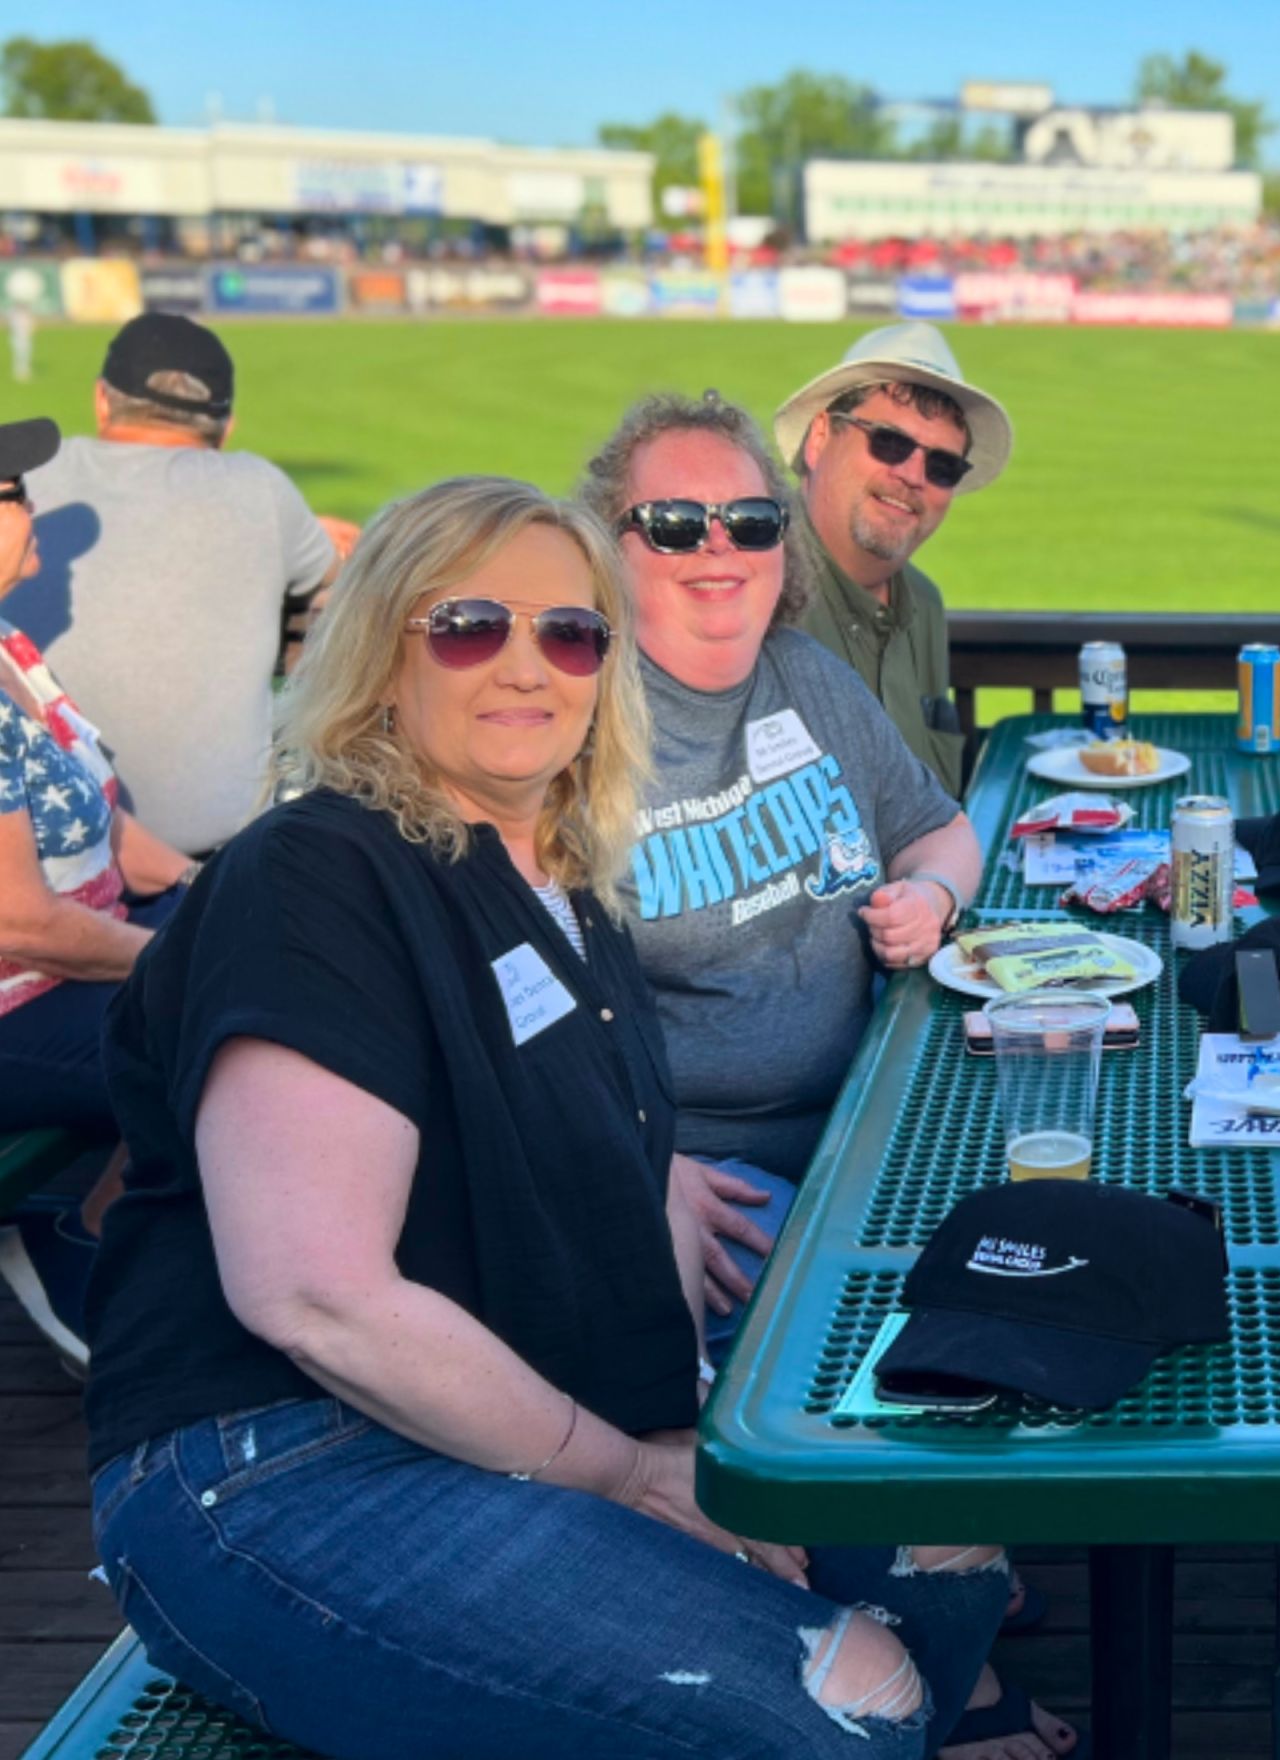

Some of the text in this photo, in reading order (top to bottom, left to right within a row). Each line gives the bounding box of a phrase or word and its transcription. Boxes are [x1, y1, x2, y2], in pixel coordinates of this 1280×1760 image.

[631, 754, 862, 921] WHITECAPS
[732, 872, 801, 926] Baseball
[1190, 849, 1210, 928] VIZZY
[998, 1239, 1048, 1260] SMILES
